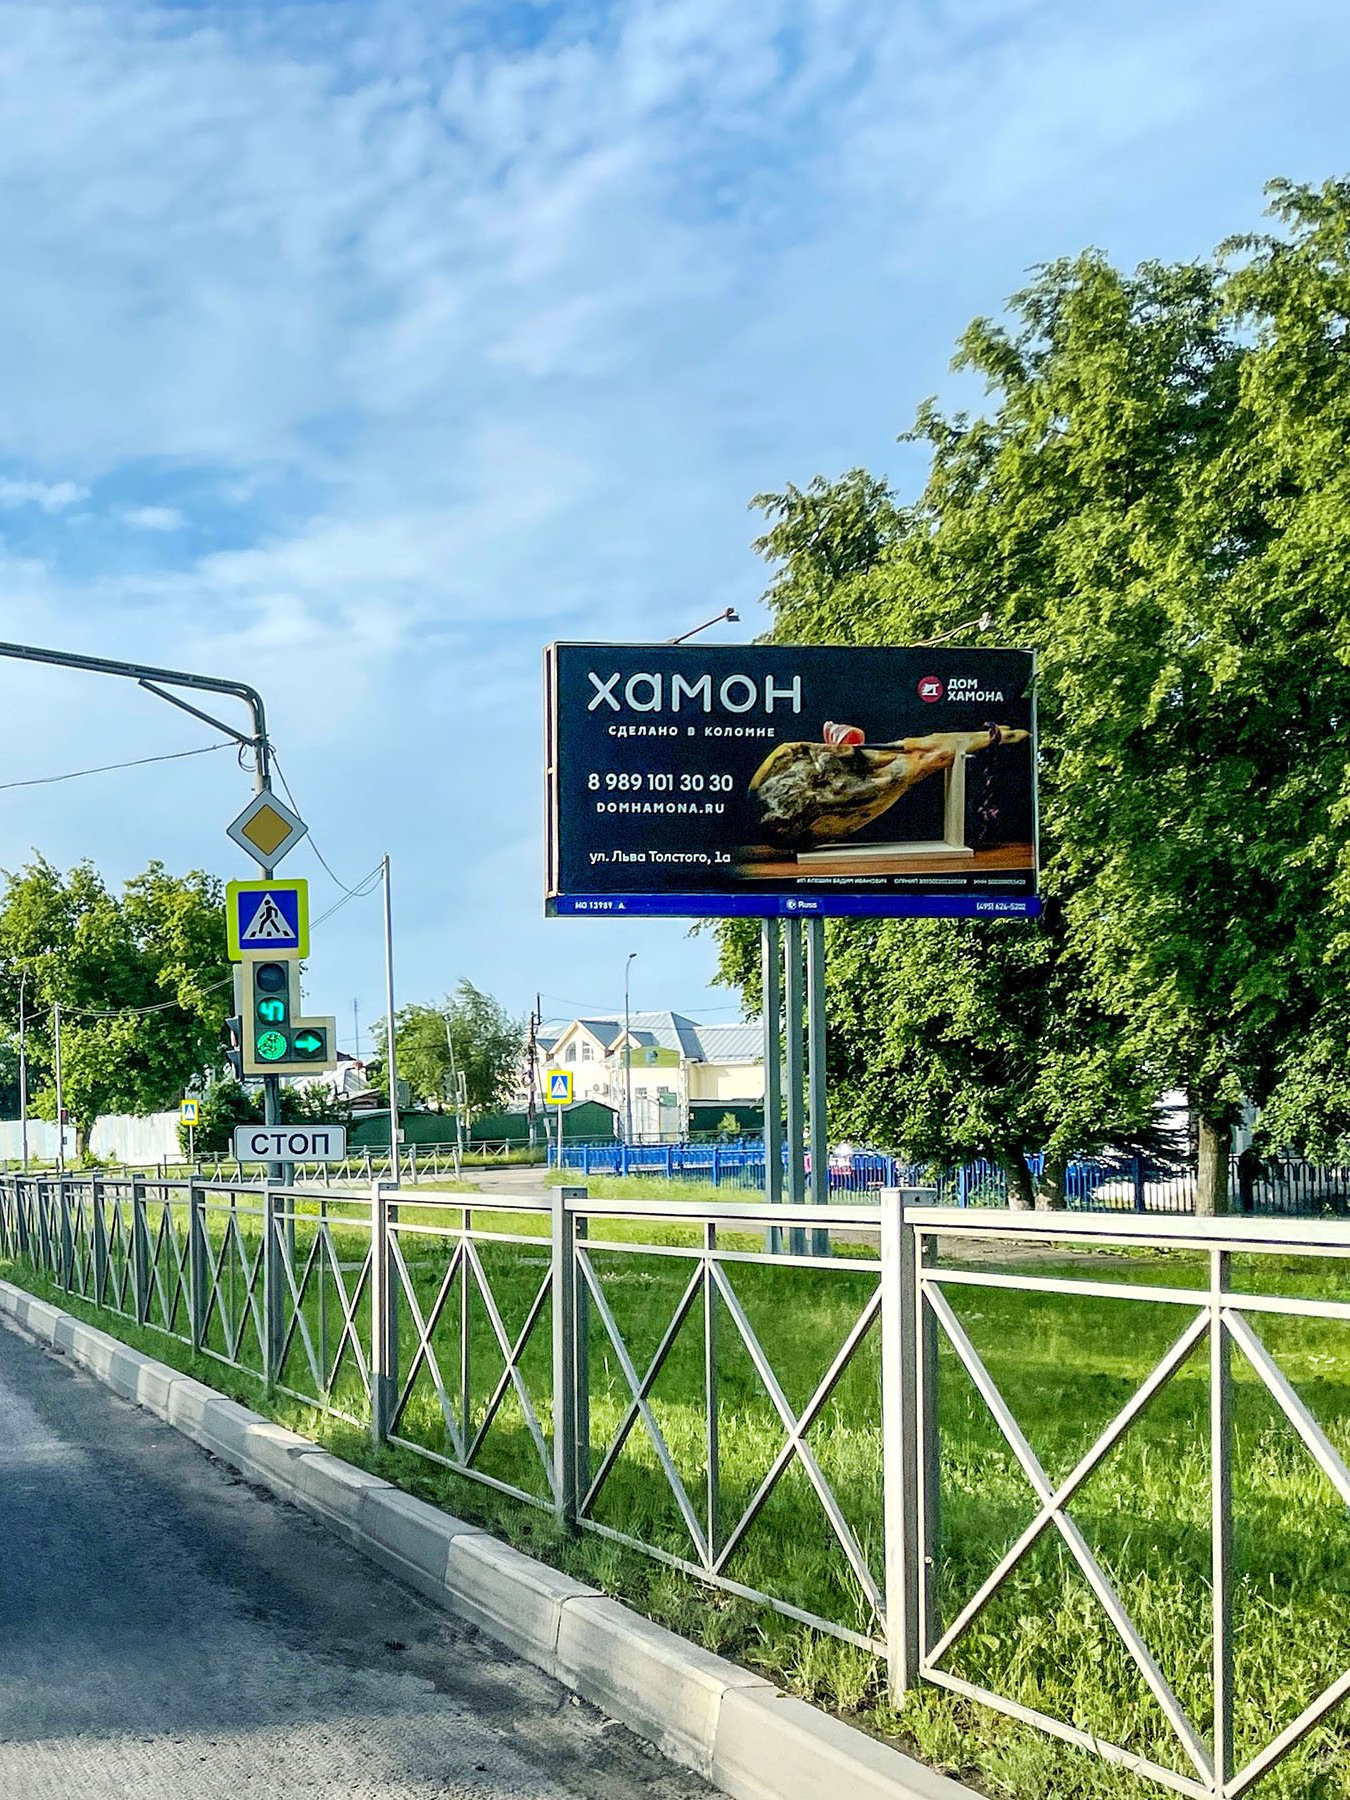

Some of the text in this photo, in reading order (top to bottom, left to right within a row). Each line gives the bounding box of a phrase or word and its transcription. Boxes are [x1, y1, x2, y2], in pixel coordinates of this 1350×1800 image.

[947, 678, 978, 690] ДОМ
[947, 690, 1004, 702] ХАМОНА
[608, 725, 775, 738] СДЕЛАНО В КОЛОМНЕ
[587, 773, 733, 792] 8 989 101 30 30
[596, 802, 725, 814] DOMHAMONA.RU
[589, 850, 731, 865] ул. Льва Толстого, 1а
[260, 1001, 285, 1021] 47
[251, 1133, 329, 1155] СТОП
